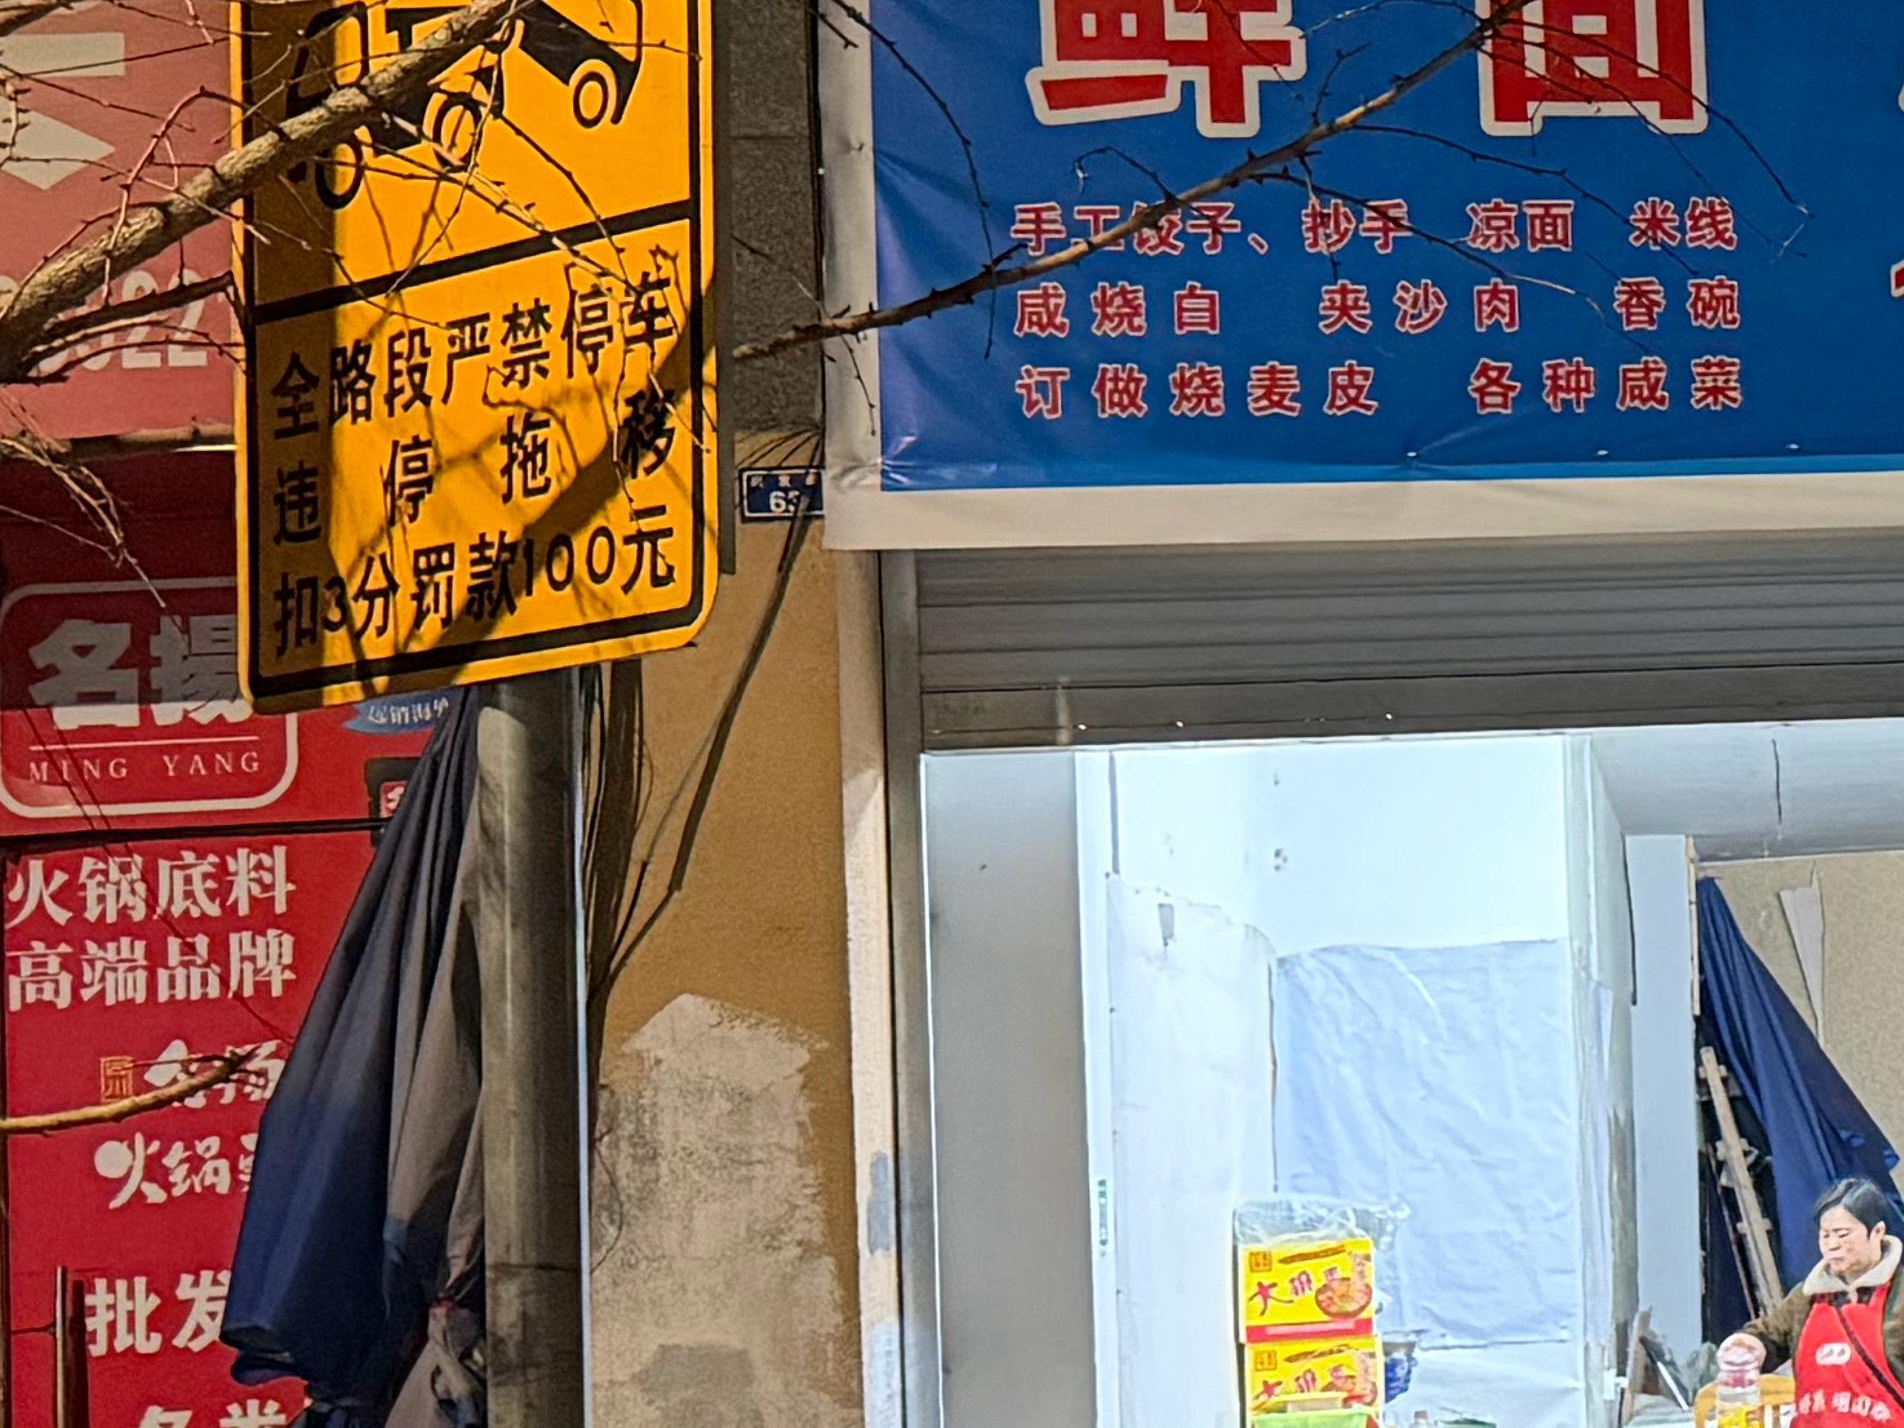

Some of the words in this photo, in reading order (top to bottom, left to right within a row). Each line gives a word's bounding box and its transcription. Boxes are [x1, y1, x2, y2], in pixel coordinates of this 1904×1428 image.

[1466, 199, 1574, 251] 凉面
[1629, 197, 1738, 250] 米线
[1318, 278, 1519, 335] 夹沙肉
[1614, 276, 1740, 331] 香碗
[272, 272, 677, 439] 全路段严禁停车
[1015, 361, 1378, 420] 订做烧麦皮
[1468, 356, 1743, 414] 各种咸菜
[274, 506, 675, 657] 扣3分罚款100元
[29, 758, 128, 783] MING
[163, 751, 260, 777] YANG
[6, 845, 296, 929] 火锅底料
[6, 929, 297, 1012] 高端品牌
[95, 1132, 258, 1209] 火锅
